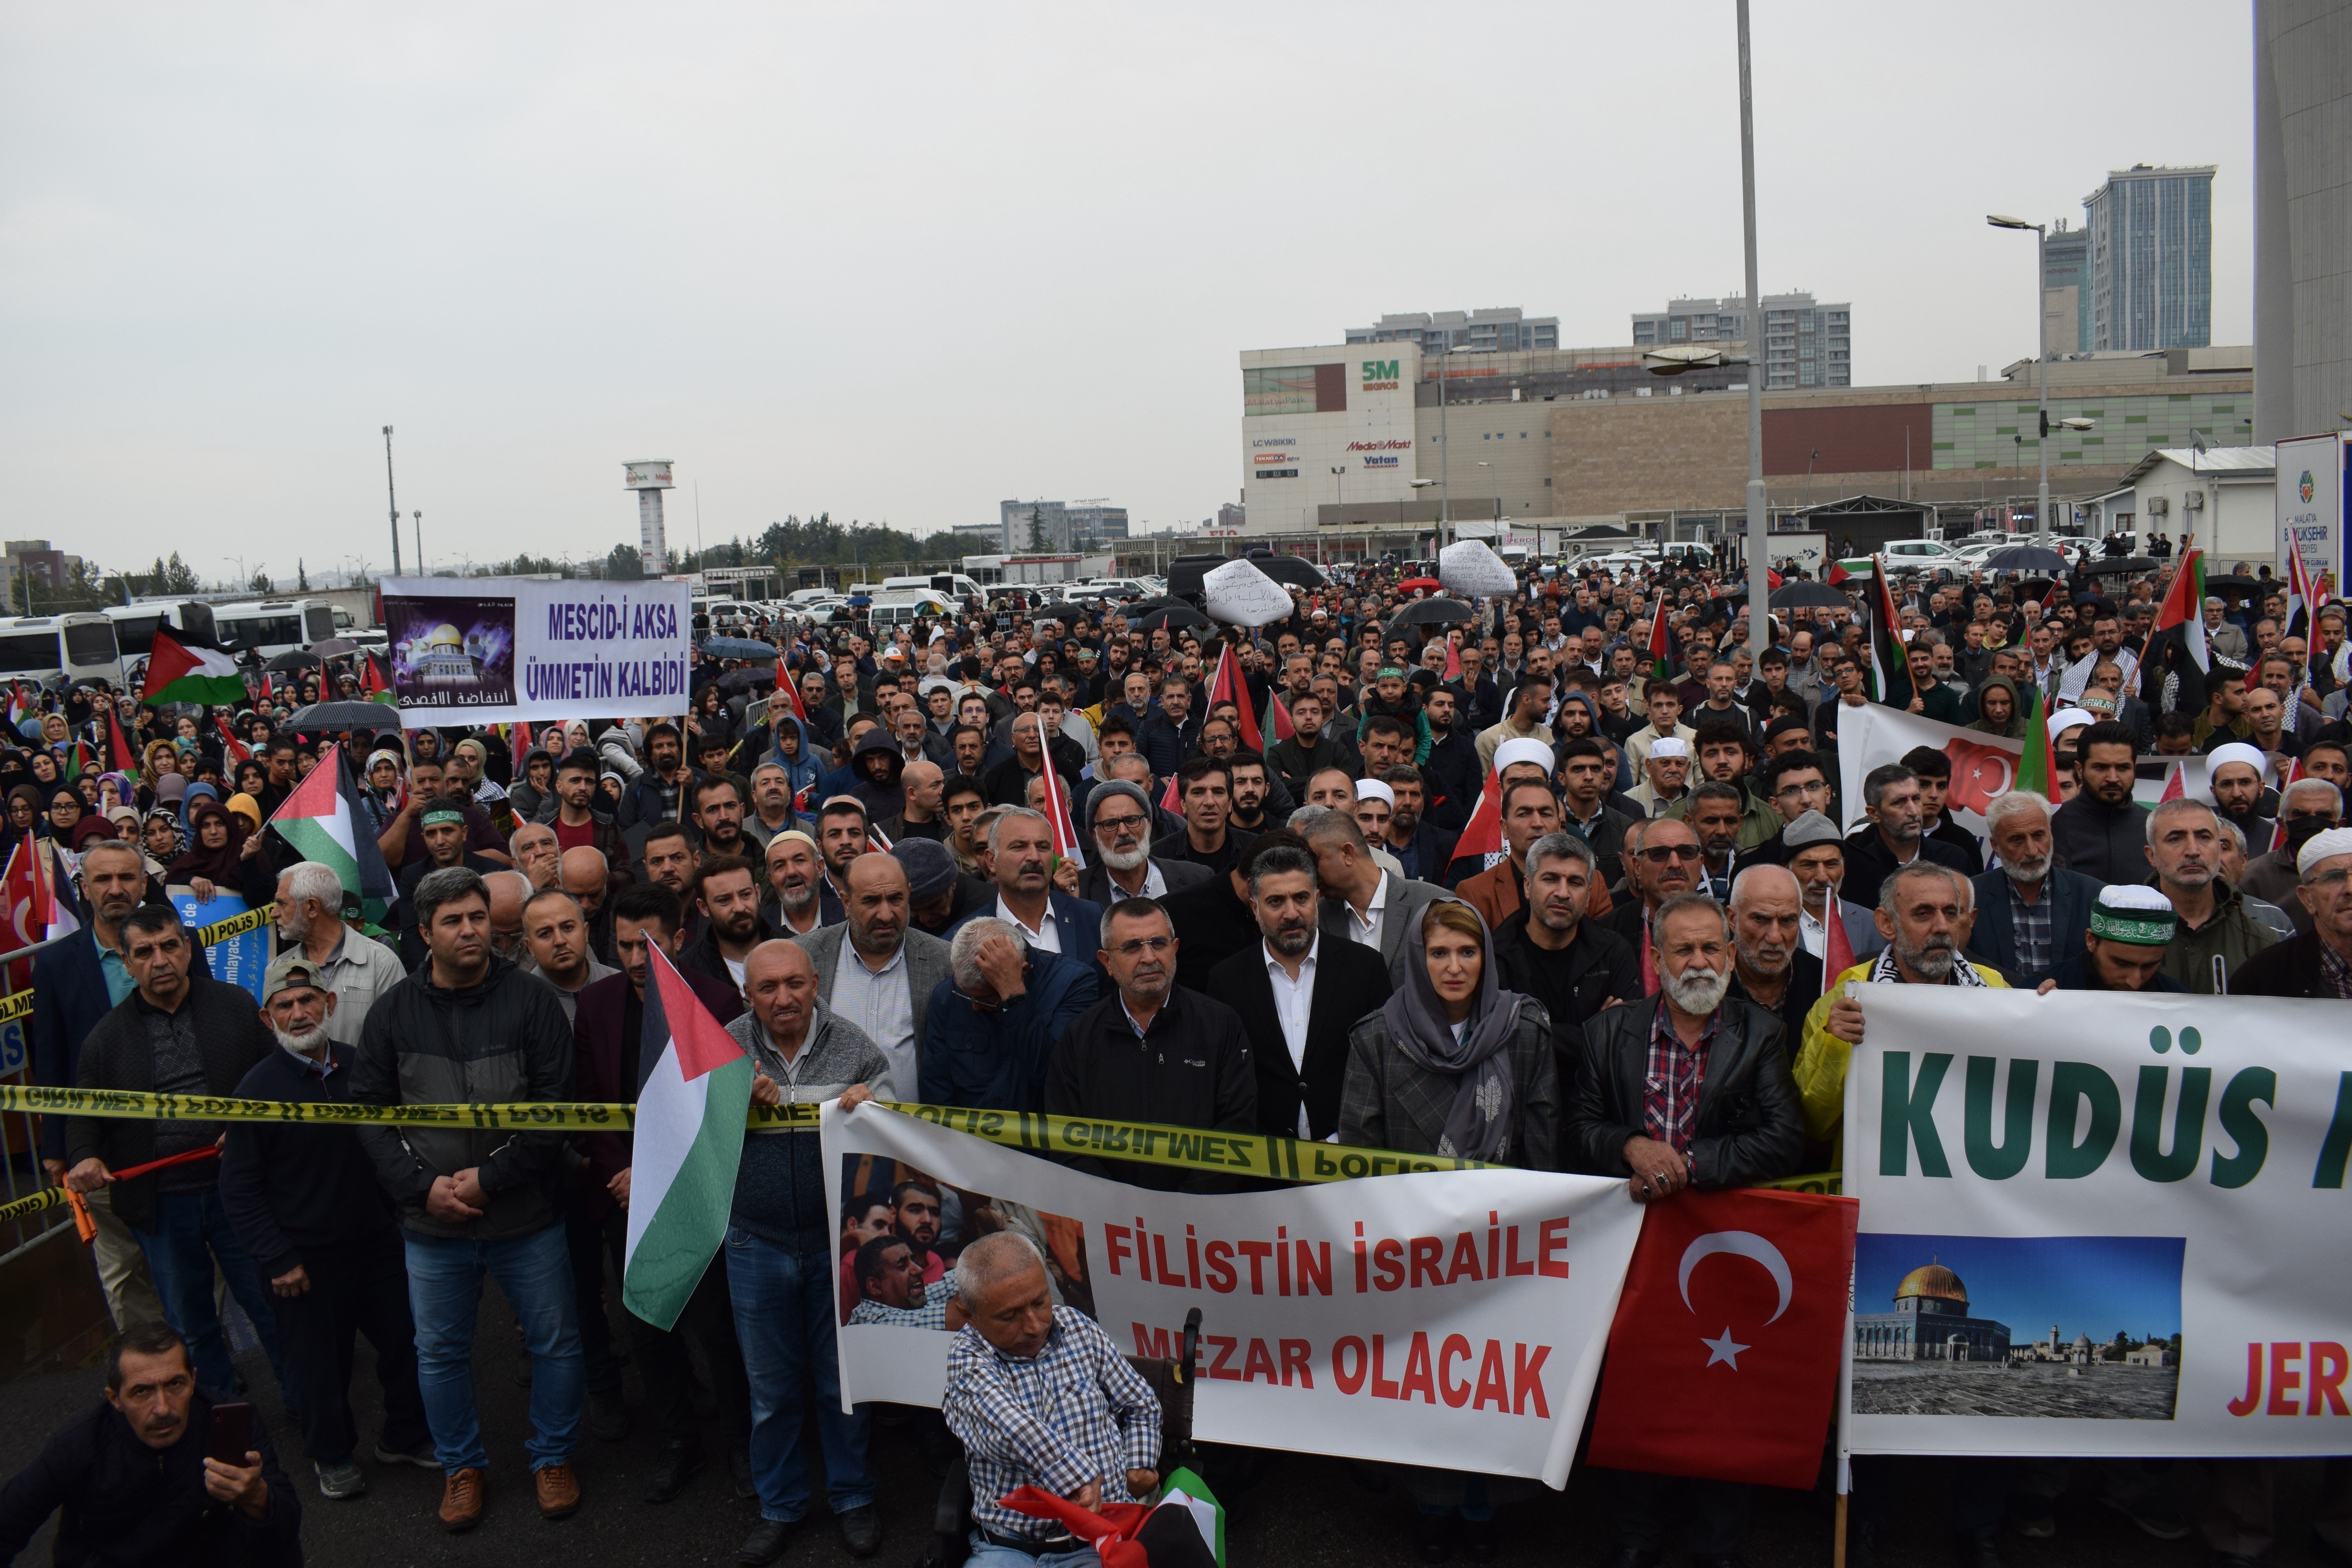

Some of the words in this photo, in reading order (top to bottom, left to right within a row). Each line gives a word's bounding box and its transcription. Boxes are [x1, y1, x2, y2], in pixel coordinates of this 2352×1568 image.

[1363, 359, 1399, 380] 5M
[1363, 382, 1398, 391] MIGROS
[1364, 456, 1398, 464] Vatan
[2295, 514, 2317, 524] MALATYA
[549, 594, 627, 640] MESCİD-İ
[633, 603, 678, 639] AKSA
[526, 653, 612, 701] ÜMMETİN
[618, 651, 684, 697] KALBİDİ
[1879, 1025, 2277, 1190] KUDÜS
[1104, 1217, 1333, 1296] FİLİSTİN
[1354, 1210, 1570, 1293] İSRAİLE
[1332, 1331, 1552, 1419] OLACAK
